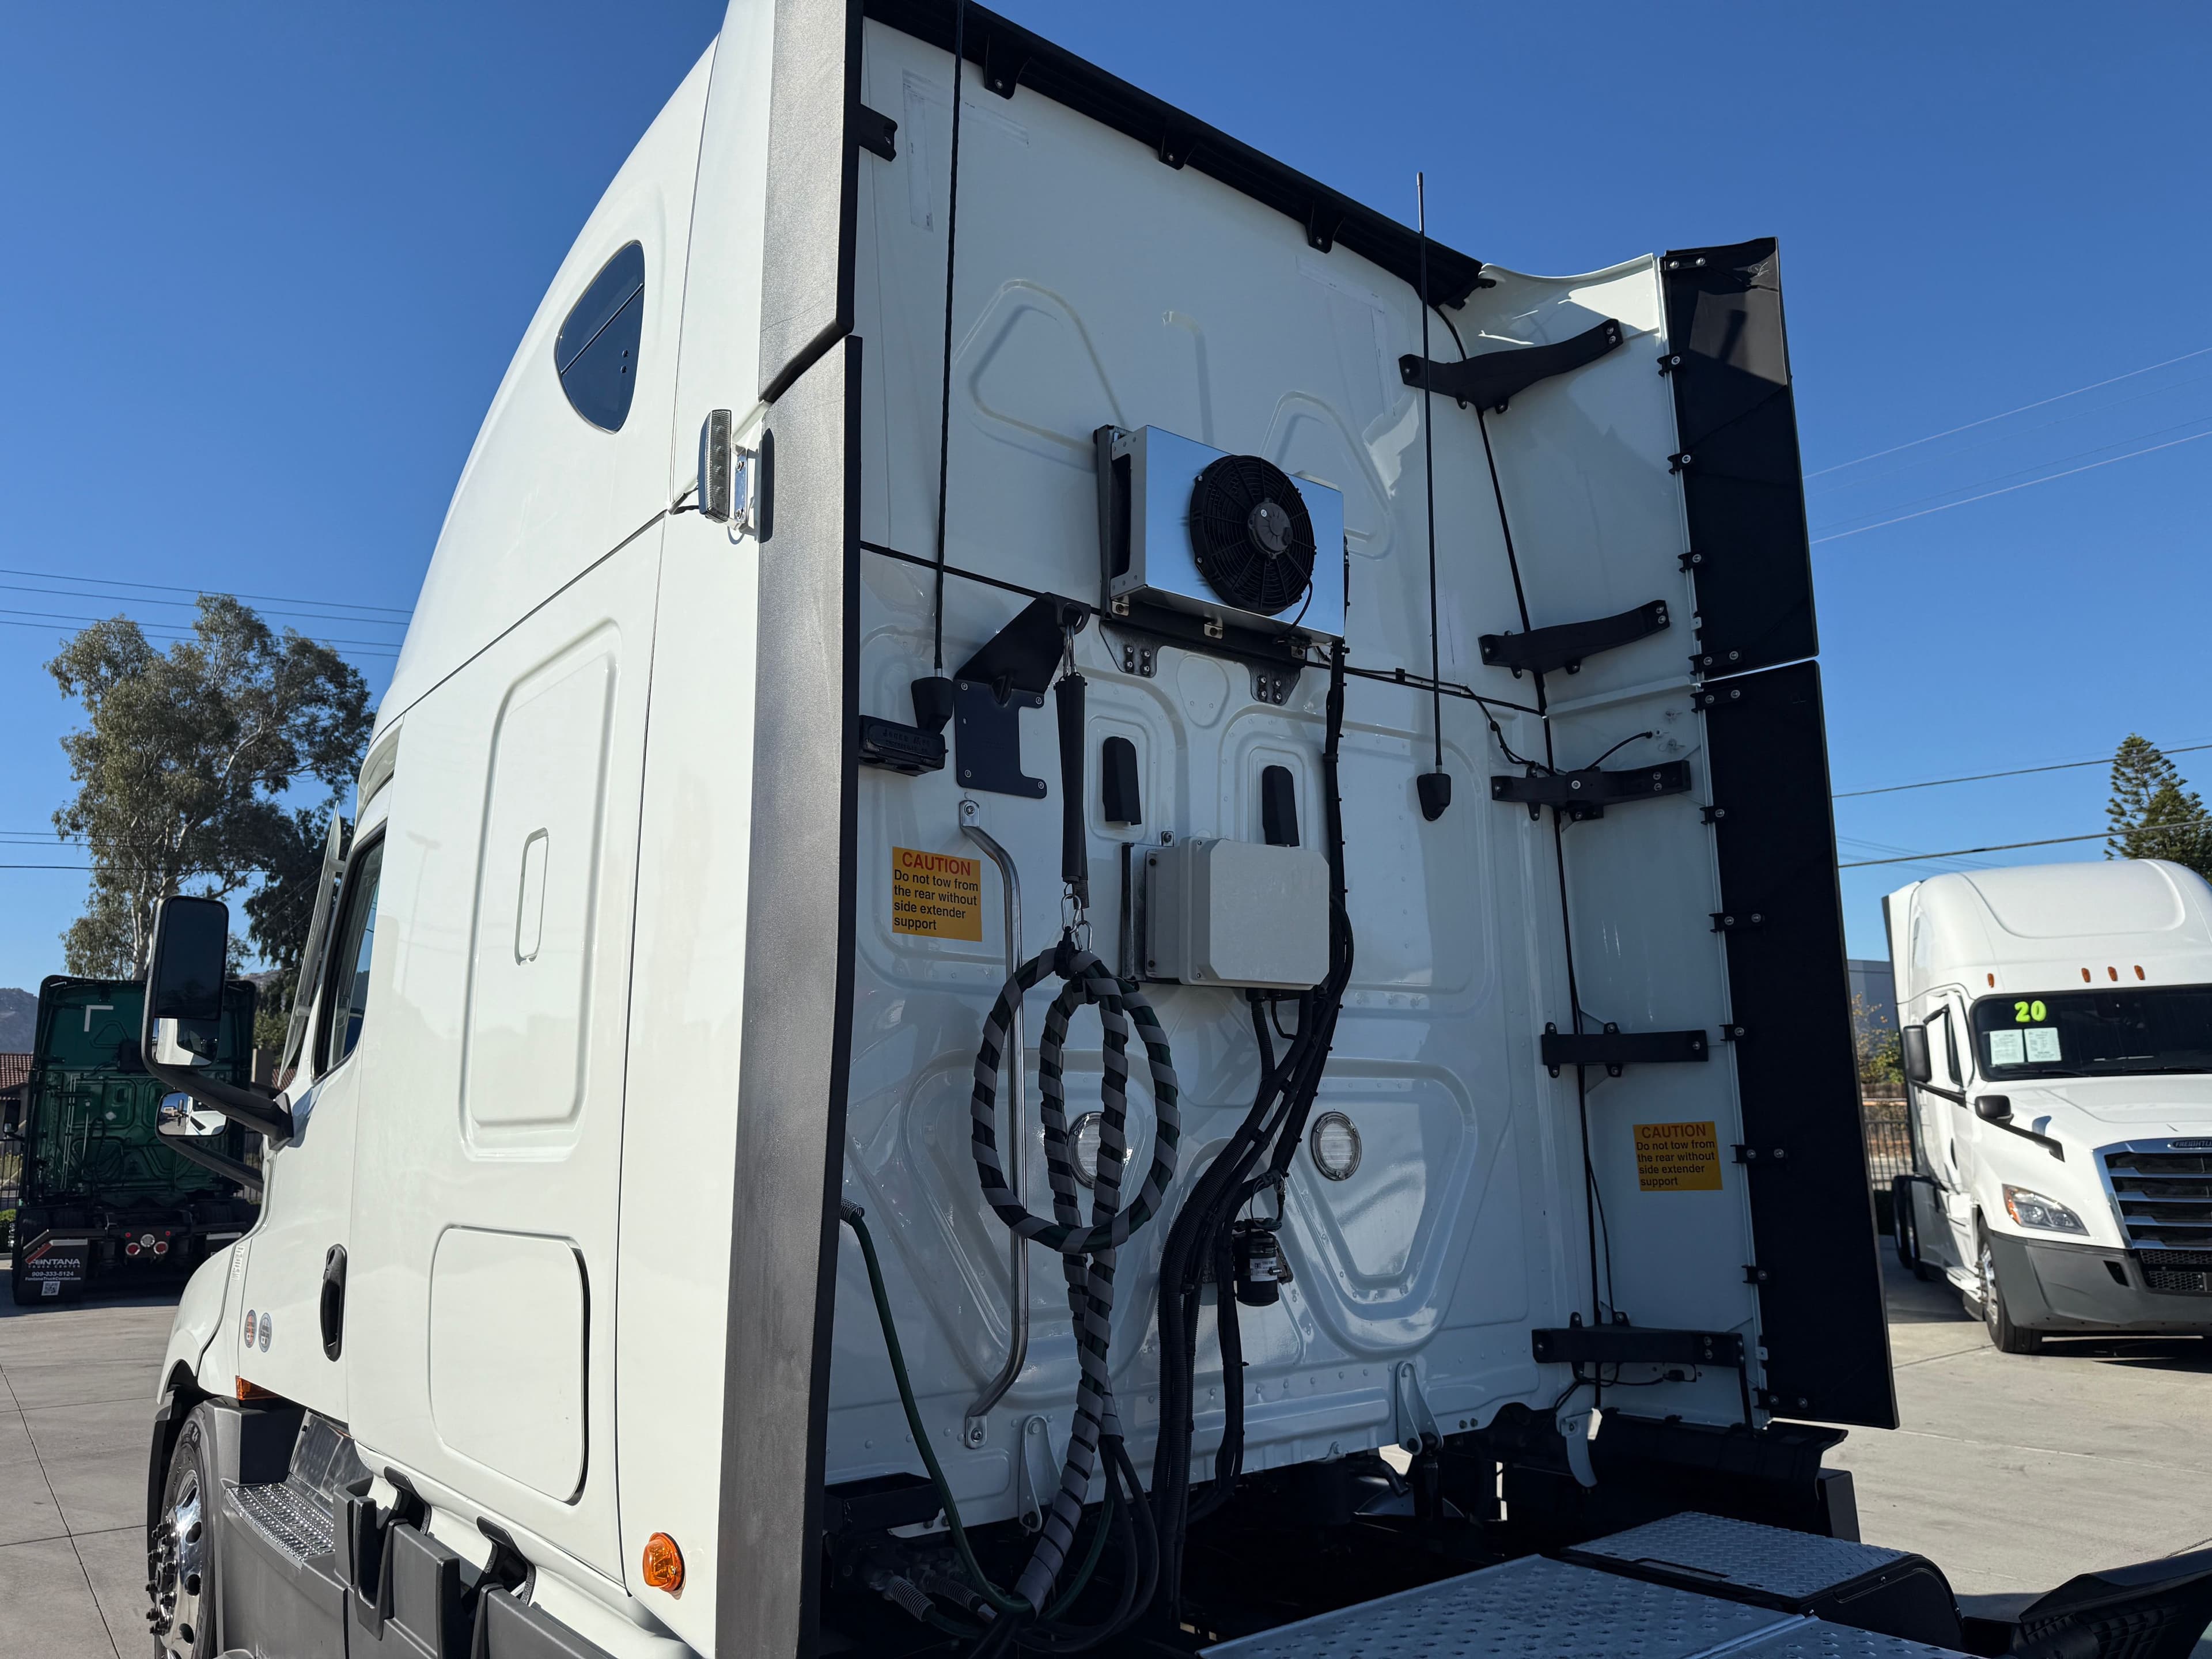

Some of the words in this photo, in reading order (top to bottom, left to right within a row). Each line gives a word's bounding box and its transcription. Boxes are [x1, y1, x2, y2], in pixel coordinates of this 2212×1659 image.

[902, 851, 971, 876] CAUTION
[894, 869, 909, 881] Do
[912, 874, 929, 884] not
[933, 876, 951, 888] tow
[954, 878, 978, 891] from
[894, 884, 911, 897] the
[914, 889, 935, 900] rear
[938, 892, 977, 906] without
[894, 900, 916, 912] side
[920, 904, 965, 919] extender
[894, 916, 937, 931] support
[2014, 1000, 2047, 1022] 20
[1642, 1124, 1706, 1138] CAUTION
[1637, 1142, 1649, 1150] Do
[1652, 1141, 1668, 1150] not
[1671, 1141, 1688, 1149] tow
[1691, 1140, 1715, 1149] from
[1638, 1154, 1653, 1162] the
[1656, 1154, 1675, 1162] rear
[1677, 1152, 1715, 1161] without
[1639, 1165, 1659, 1174] side
[1662, 1164, 1705, 1173] extender
[1641, 1177, 1678, 1188] support
